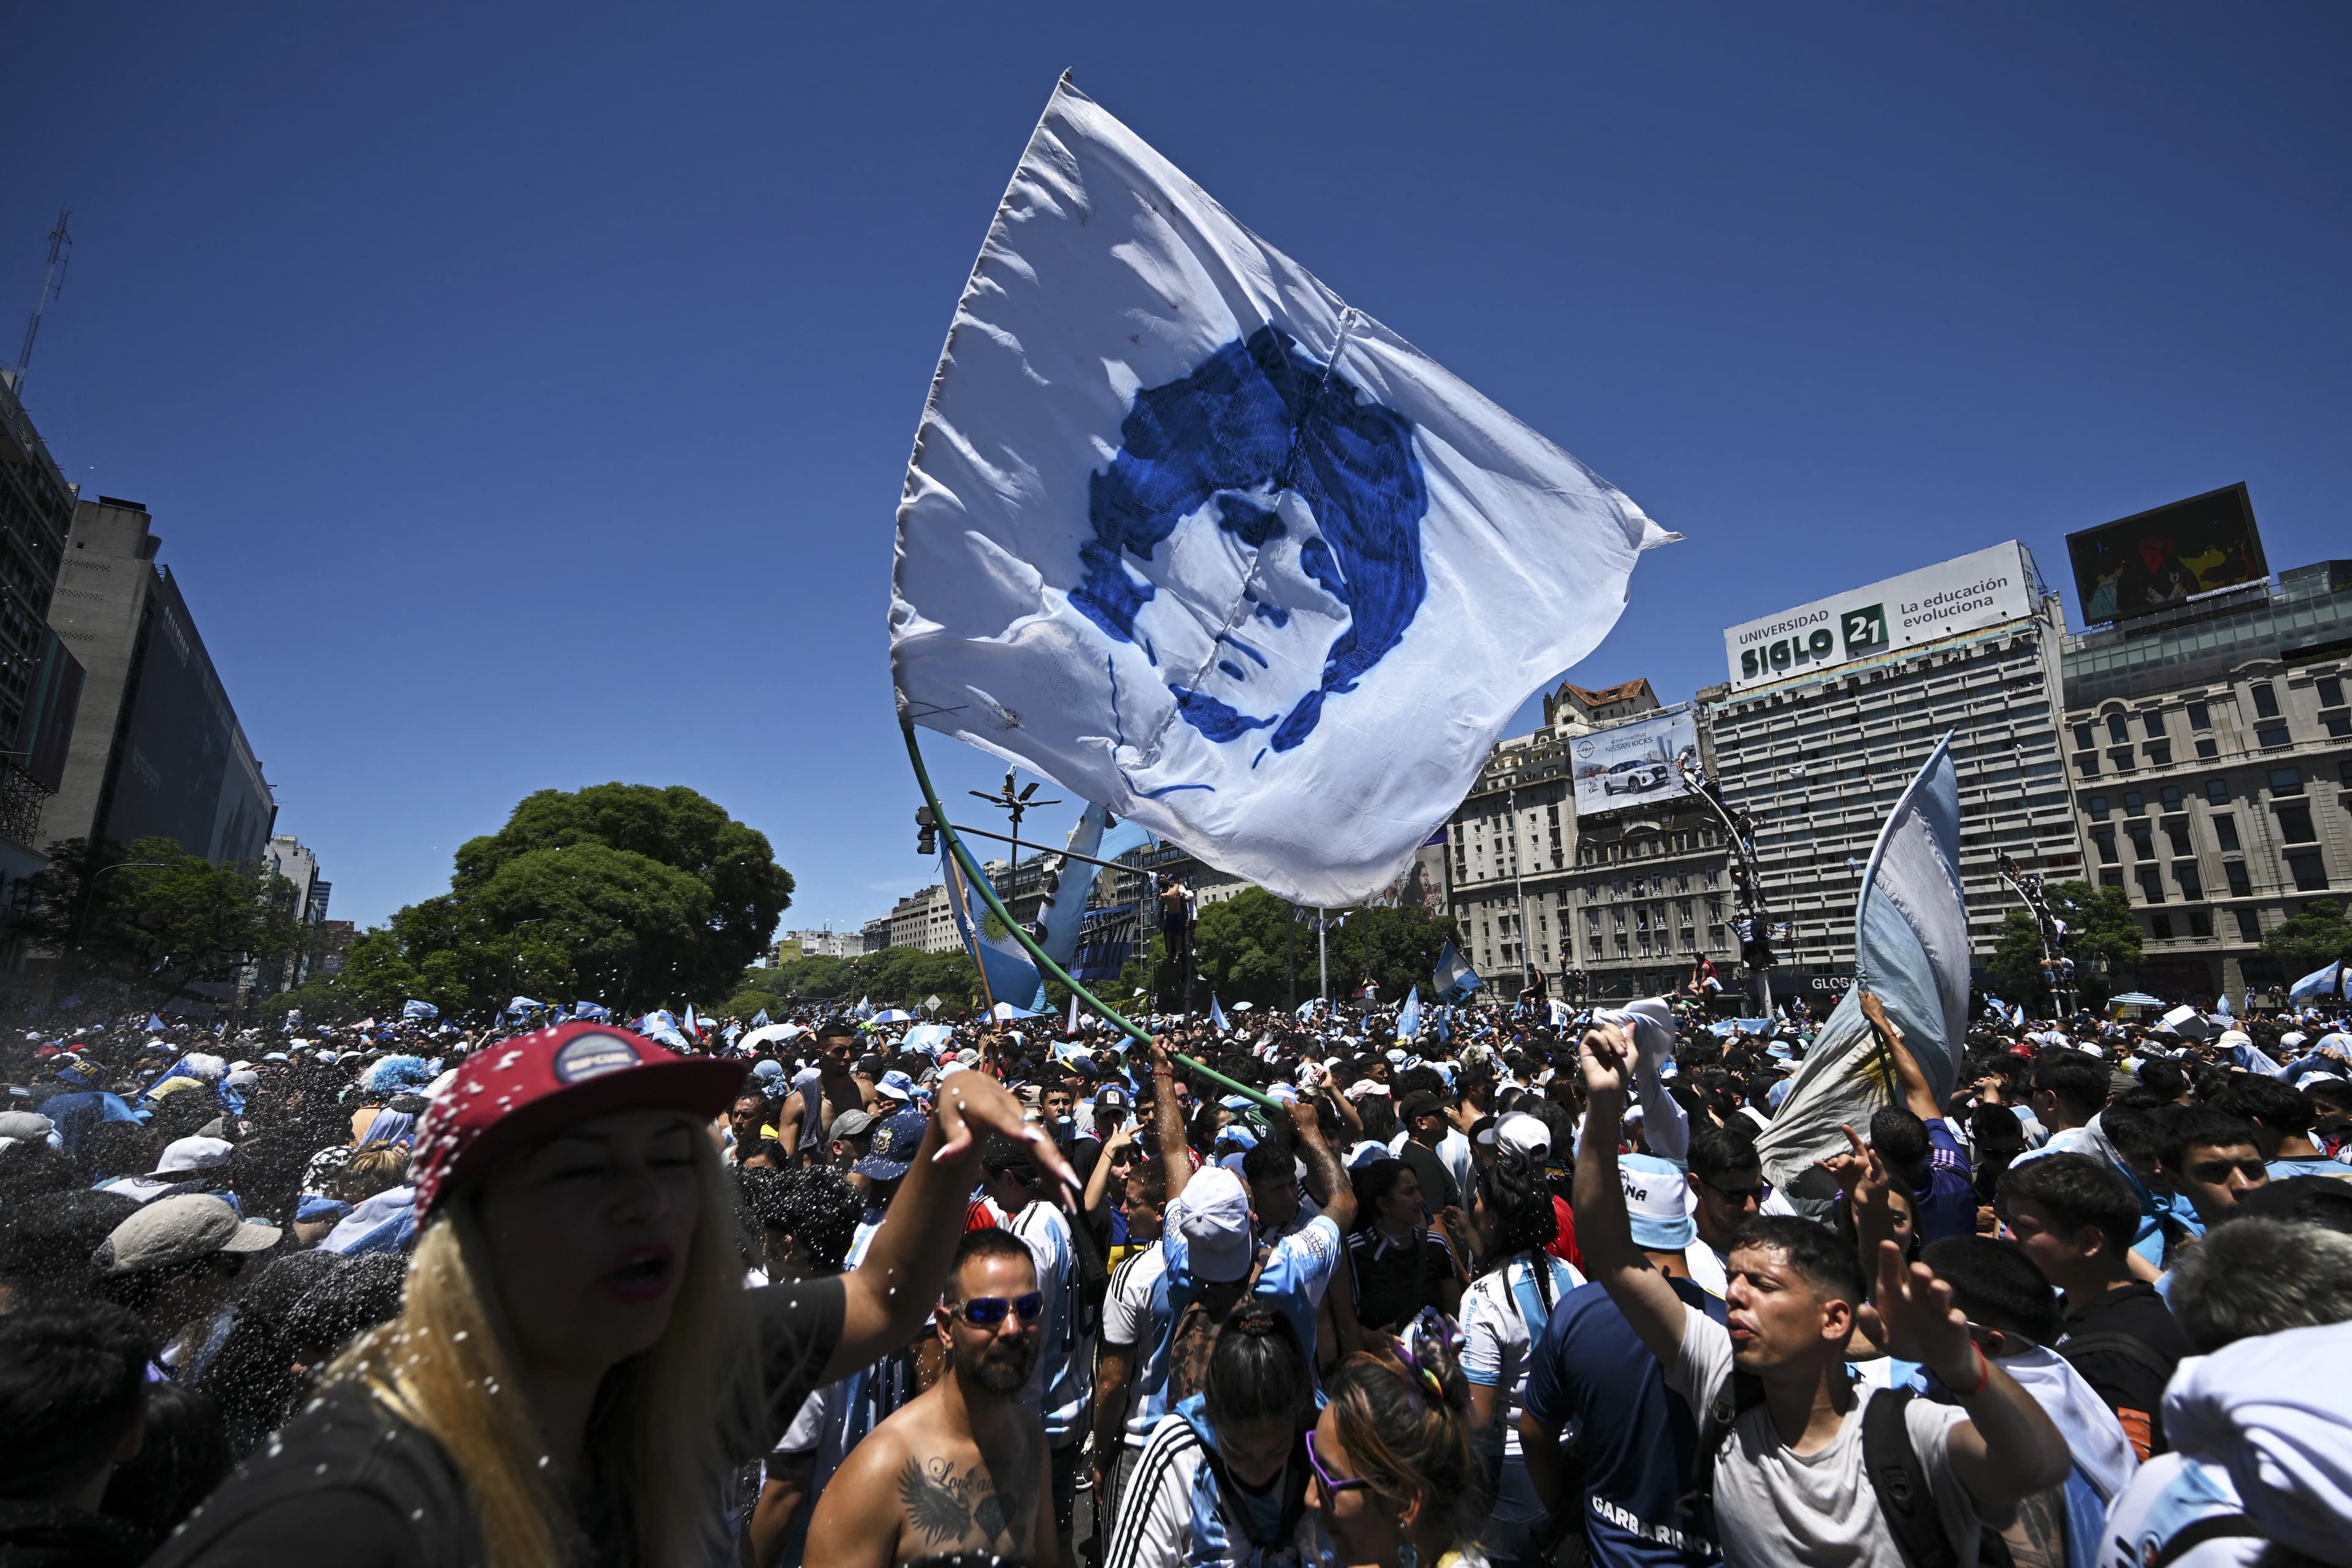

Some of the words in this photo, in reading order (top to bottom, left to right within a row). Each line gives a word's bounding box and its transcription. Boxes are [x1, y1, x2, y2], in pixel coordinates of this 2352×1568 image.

[1901, 603, 1918, 614] La
[1923, 578, 2008, 608] educación
[1904, 596, 1994, 628] evoluciona
[1740, 610, 1829, 644] UNIVERSIDAD
[1741, 628, 1834, 673] SIGLO
[1849, 616, 1880, 644] 21
[1605, 742, 1630, 753] NISSAN
[1632, 736, 1653, 747] KICKS
[1556, 1004, 1566, 1014] 10
[73, 1060, 99, 1076] OCA
[1464, 1306, 1477, 1334] Banco
[927, 1457, 973, 1490] Love
[1592, 1494, 1712, 1556] GARBARINO
